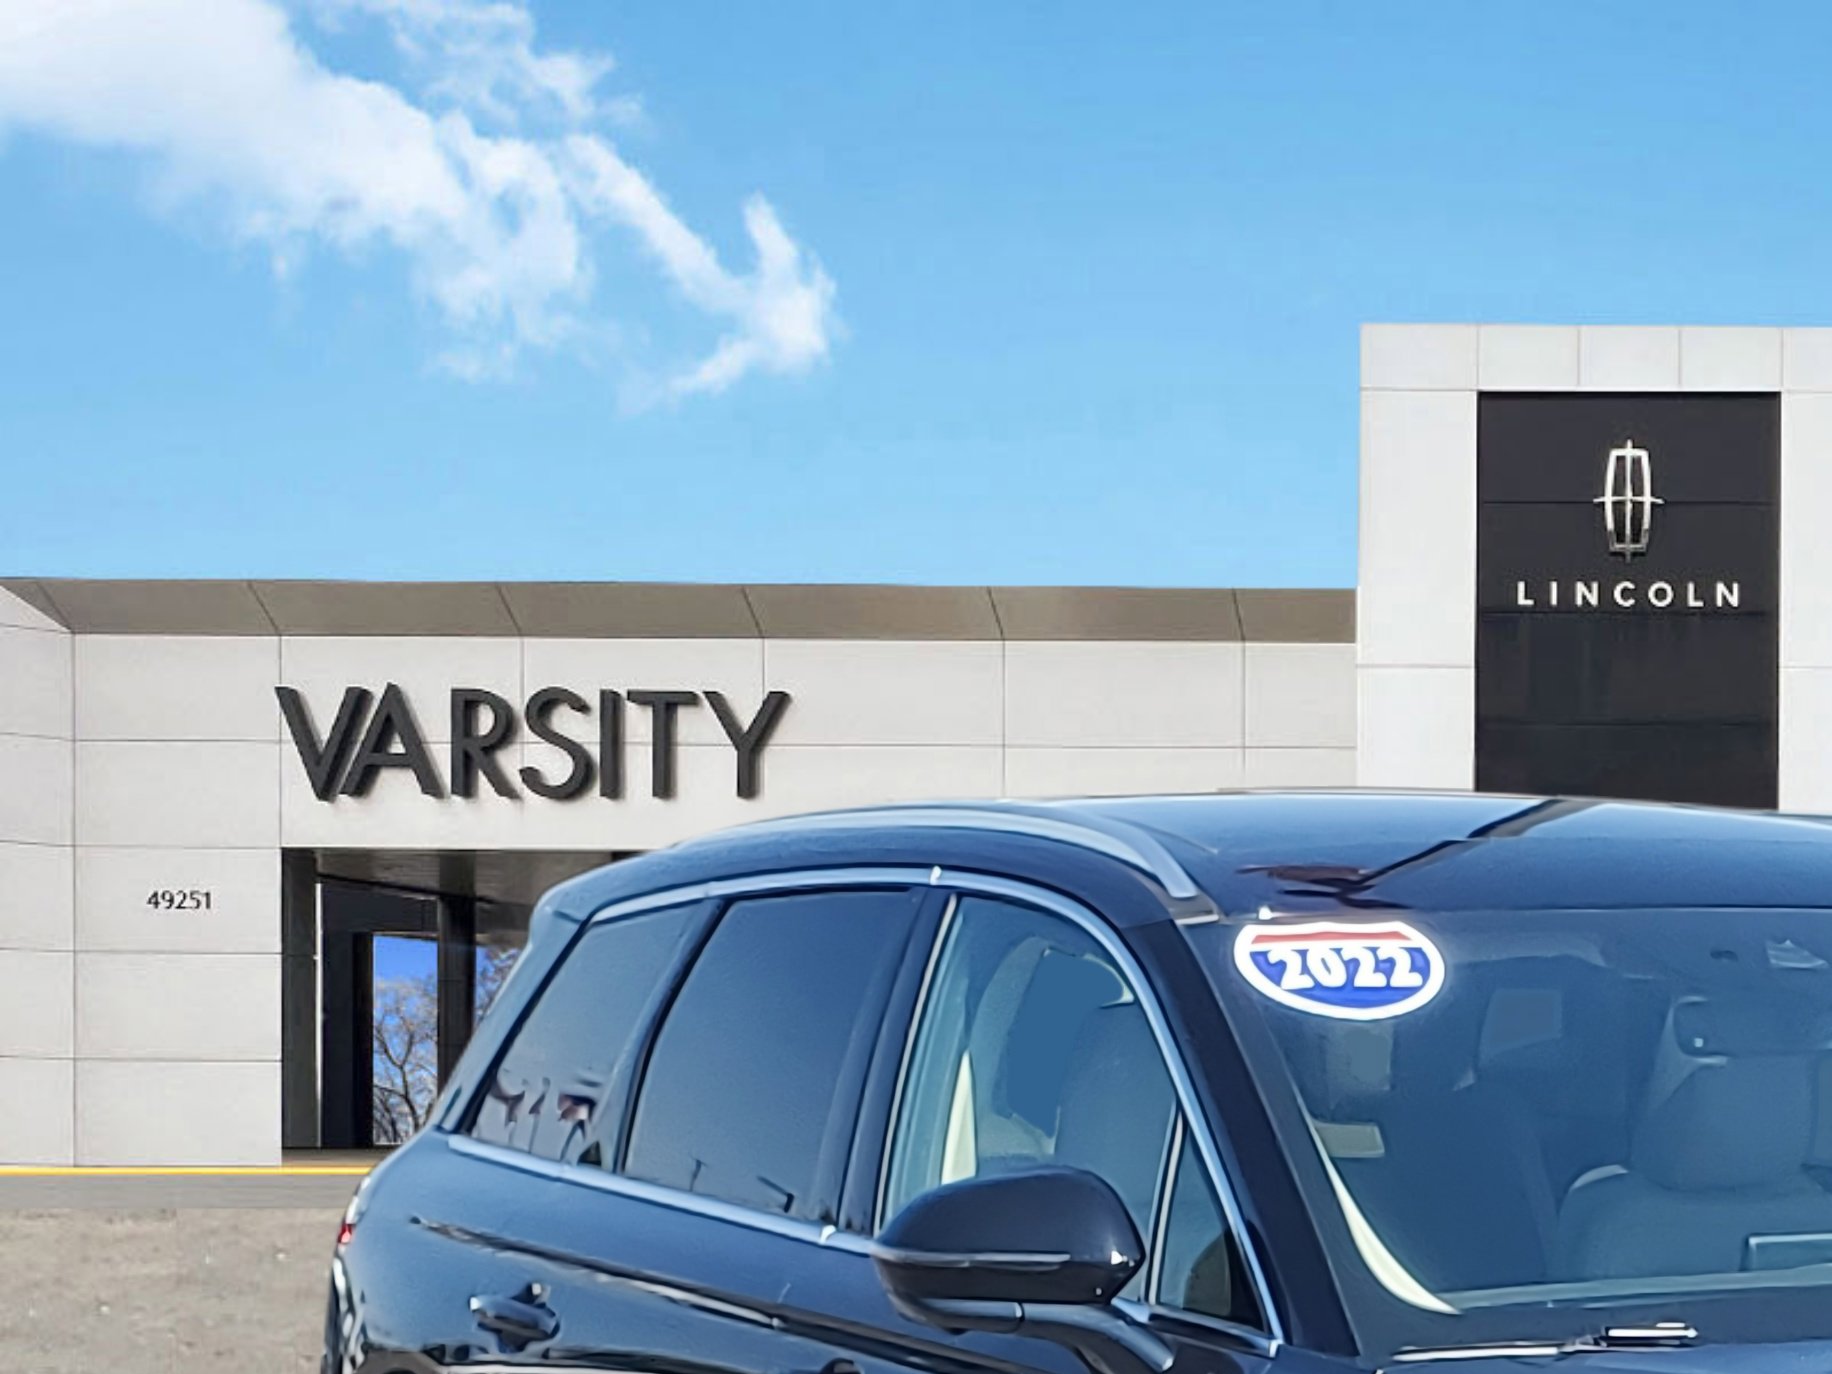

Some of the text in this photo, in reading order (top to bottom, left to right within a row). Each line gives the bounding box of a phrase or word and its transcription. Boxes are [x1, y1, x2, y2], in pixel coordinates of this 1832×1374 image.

[1517, 580, 1740, 607] LINCOLN
[274, 682, 792, 802] VARSITY
[146, 889, 211, 909] 49251
[1266, 948, 1423, 990] 2022
